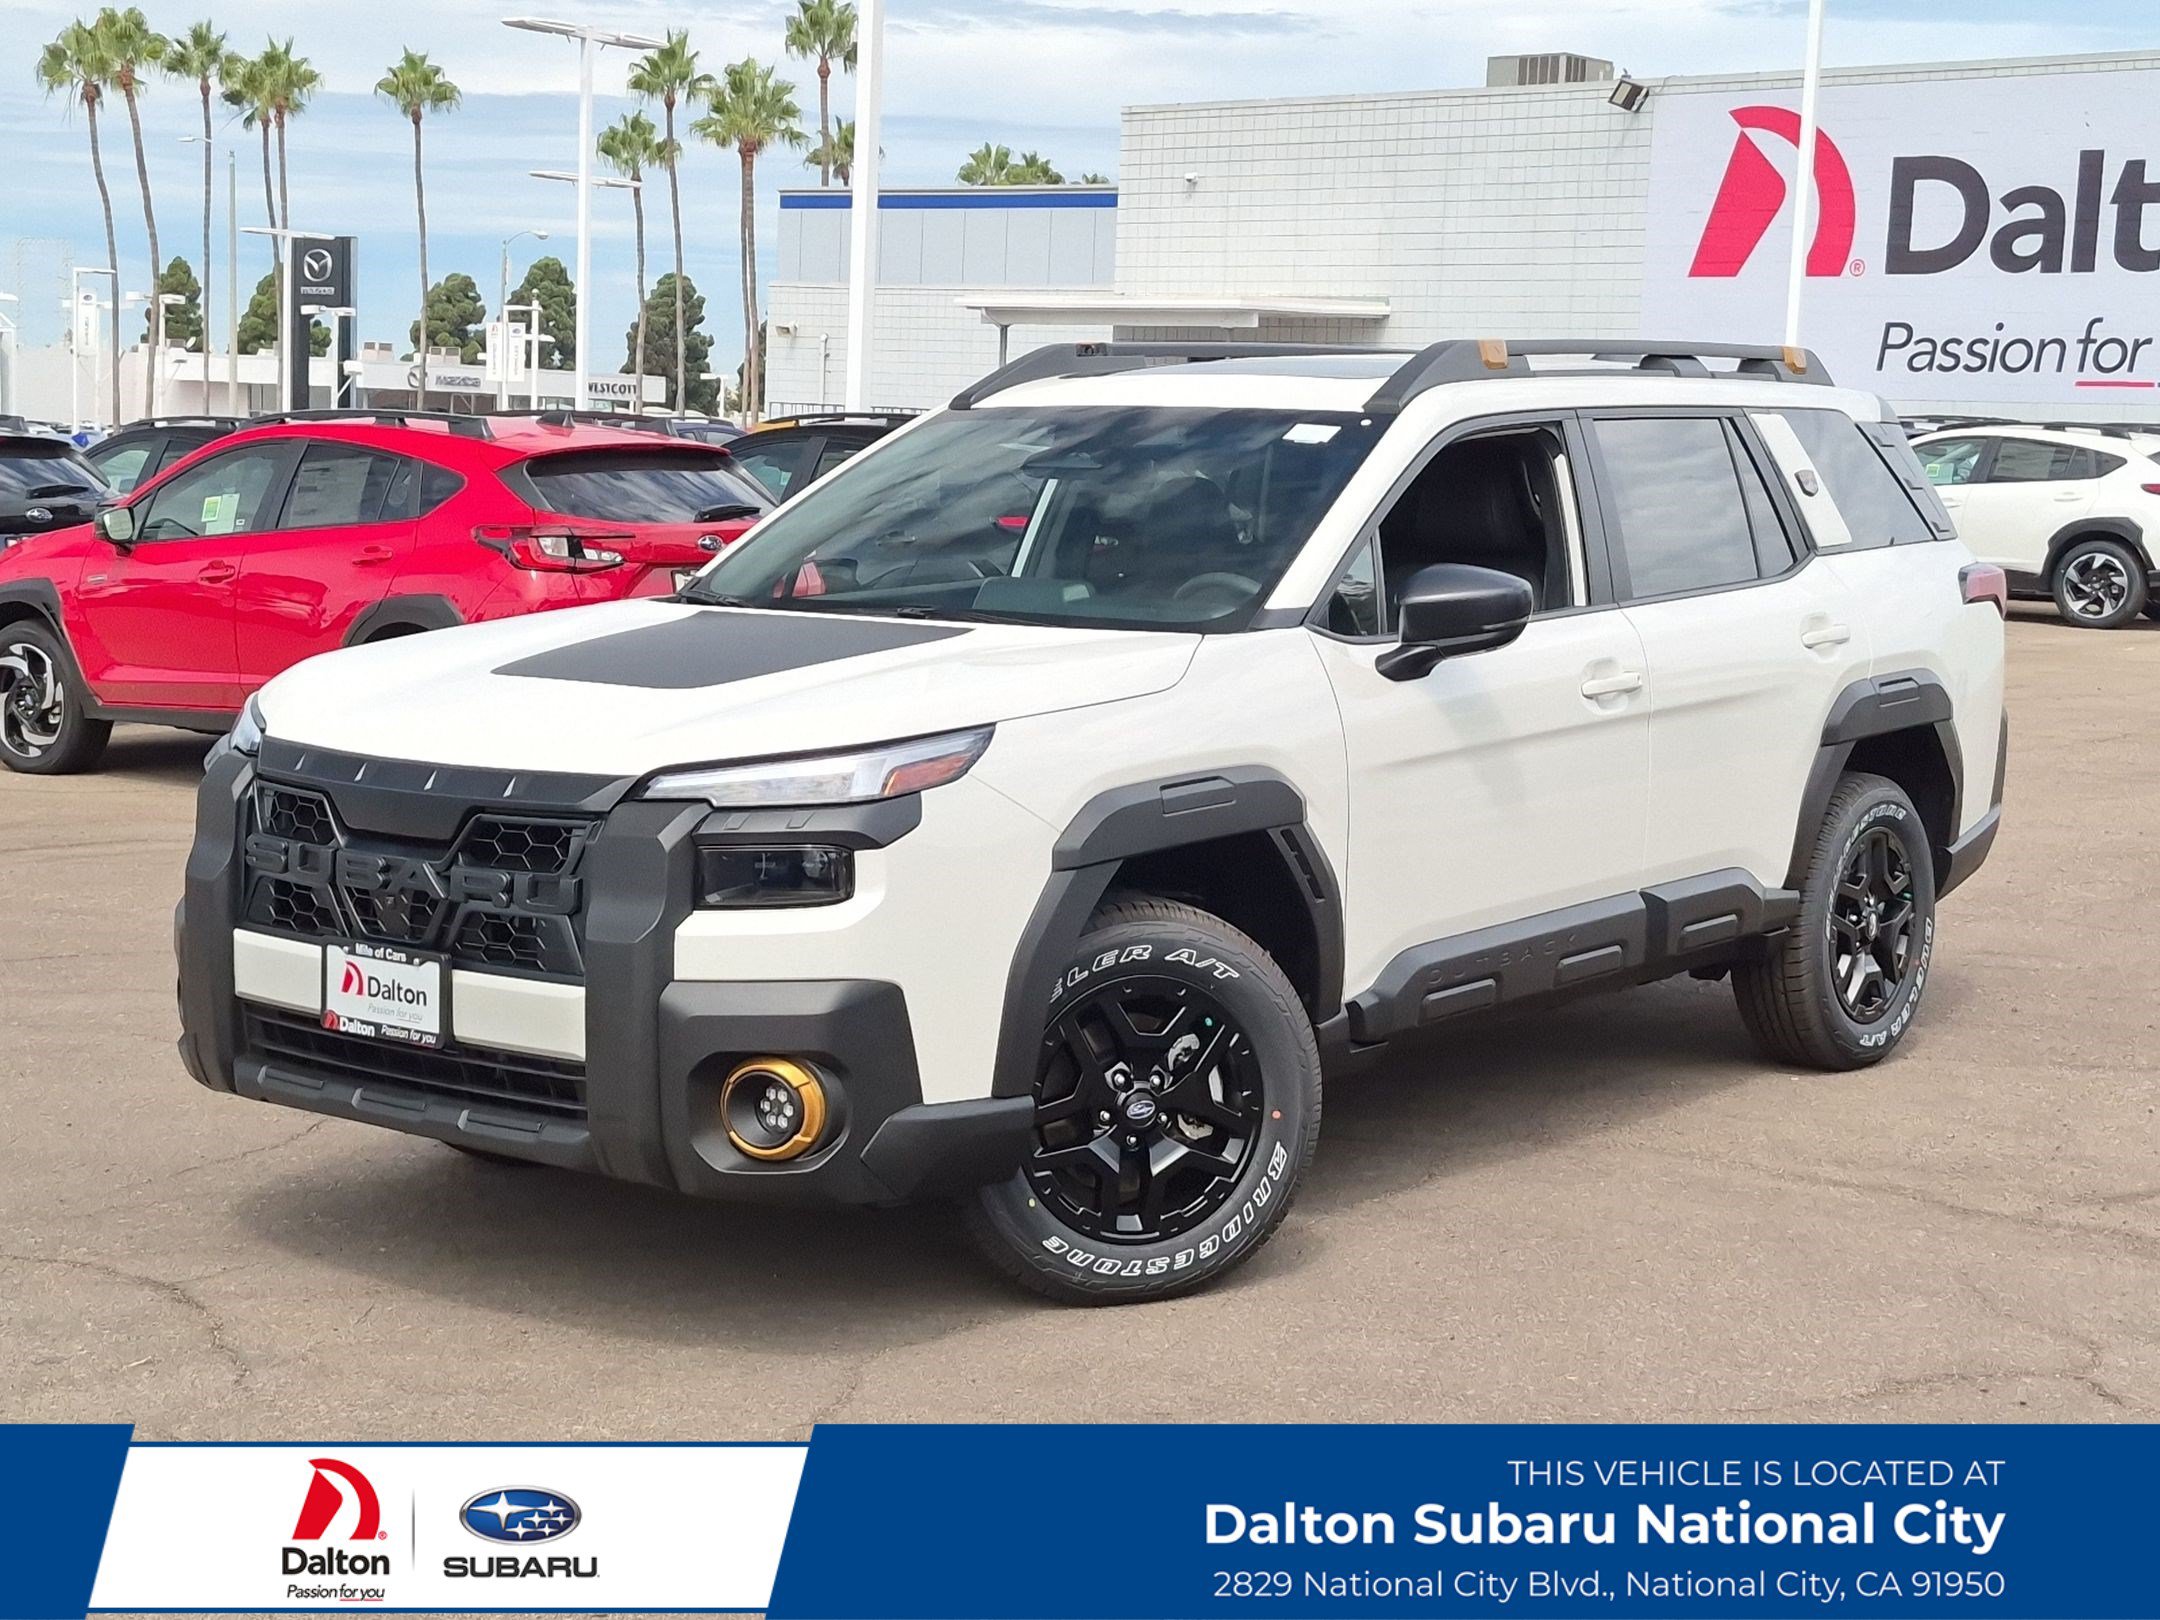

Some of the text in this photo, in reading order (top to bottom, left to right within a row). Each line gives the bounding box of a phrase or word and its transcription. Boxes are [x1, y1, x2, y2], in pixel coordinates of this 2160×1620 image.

[1876, 316, 2153, 375] Passion for
[246, 832, 583, 916] SUBARU
[374, 946, 386, 959] of
[386, 948, 407, 962] Cars
[1165, 947, 1239, 982] A/T
[367, 975, 427, 1006] Dalton
[367, 1002, 423, 1021] Passion for you
[340, 1016, 437, 1044] Dalton Passion for you
[1042, 1141, 1288, 1277] BRIDGESTONE
